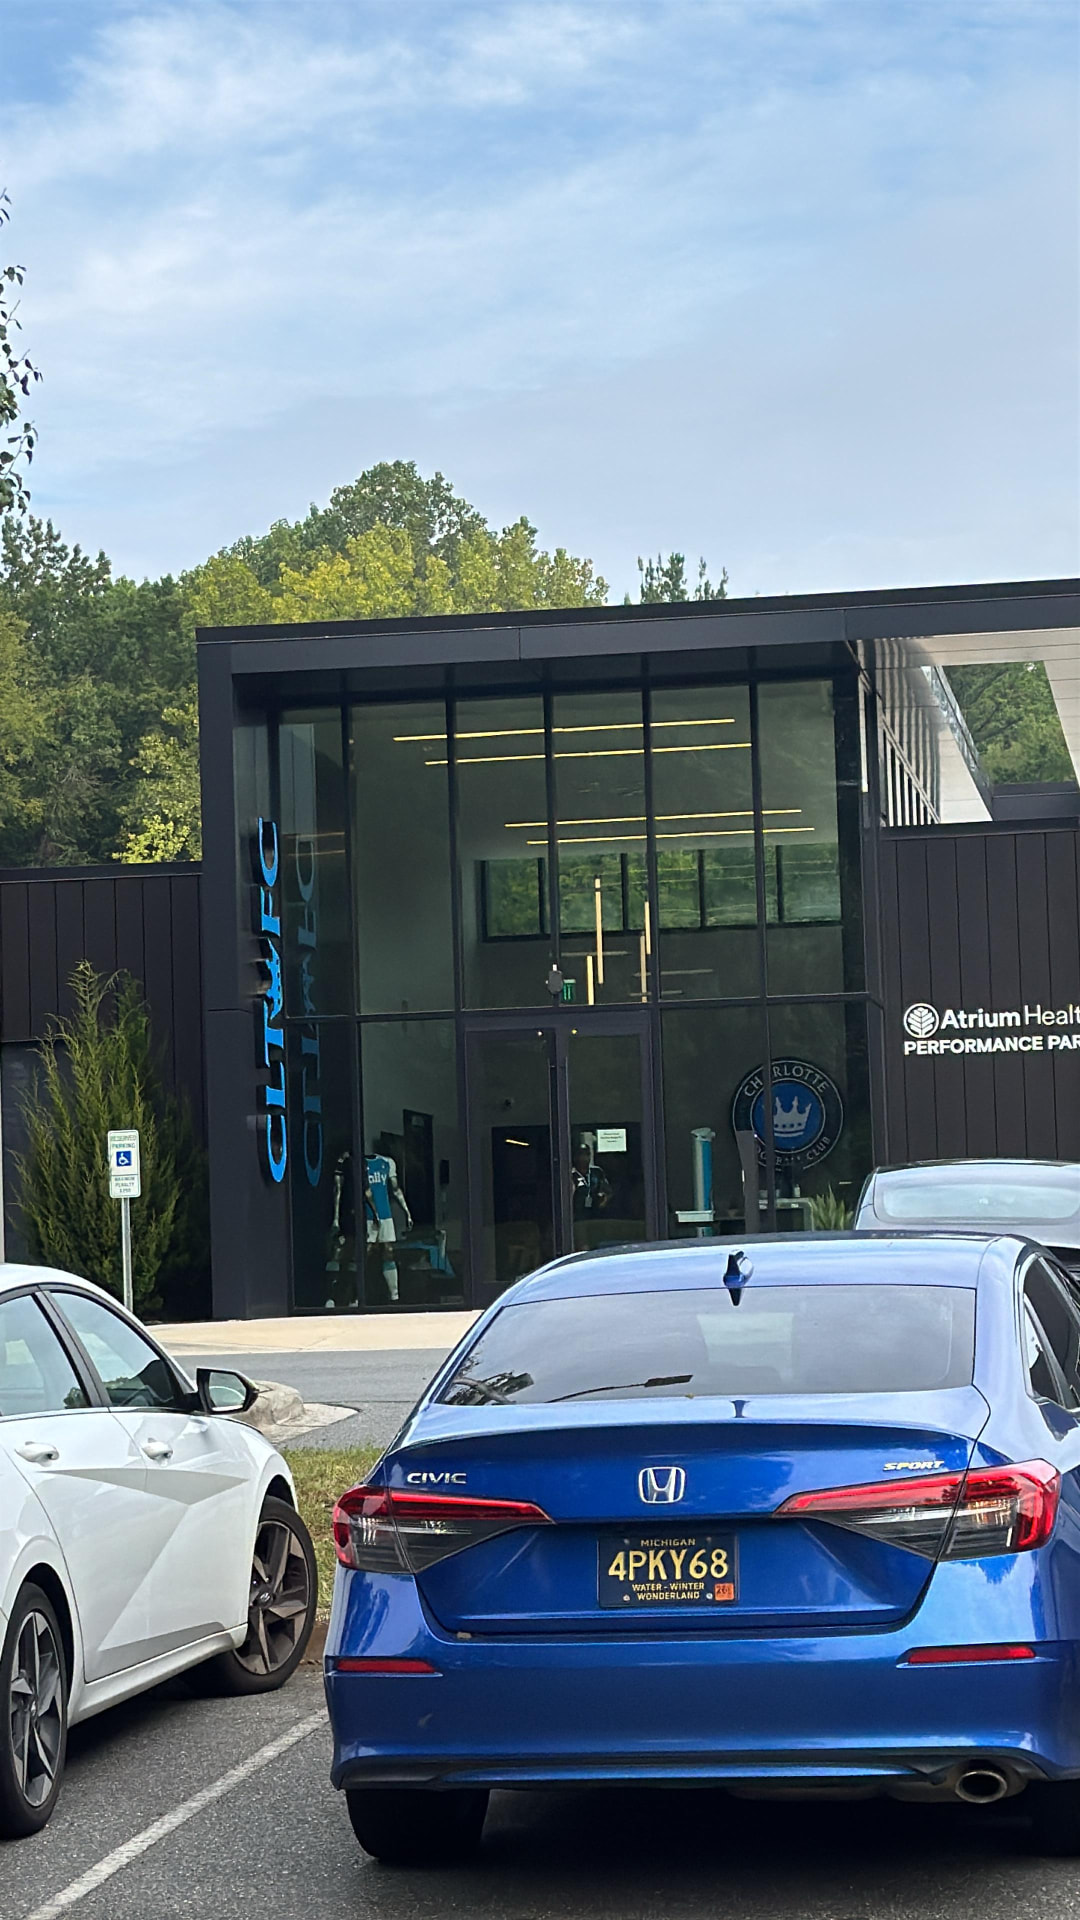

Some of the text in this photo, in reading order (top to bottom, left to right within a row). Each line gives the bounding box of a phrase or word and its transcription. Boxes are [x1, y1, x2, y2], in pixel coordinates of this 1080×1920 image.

[257, 816, 282, 937] FC
[940, 1008, 1021, 1030] Atrium
[903, 1035, 1044, 1055] PERFORMANCE
[744, 1064, 830, 1097] CHRLOTTE
[806, 1136, 831, 1160] CLUB
[882, 1460, 944, 1472] SPORT
[406, 1472, 467, 1485] CIVIC
[640, 1538, 696, 1547] MICHIGAN
[608, 1548, 729, 1581] 4PKY68
[637, 1591, 700, 1601] WONDERLAND
